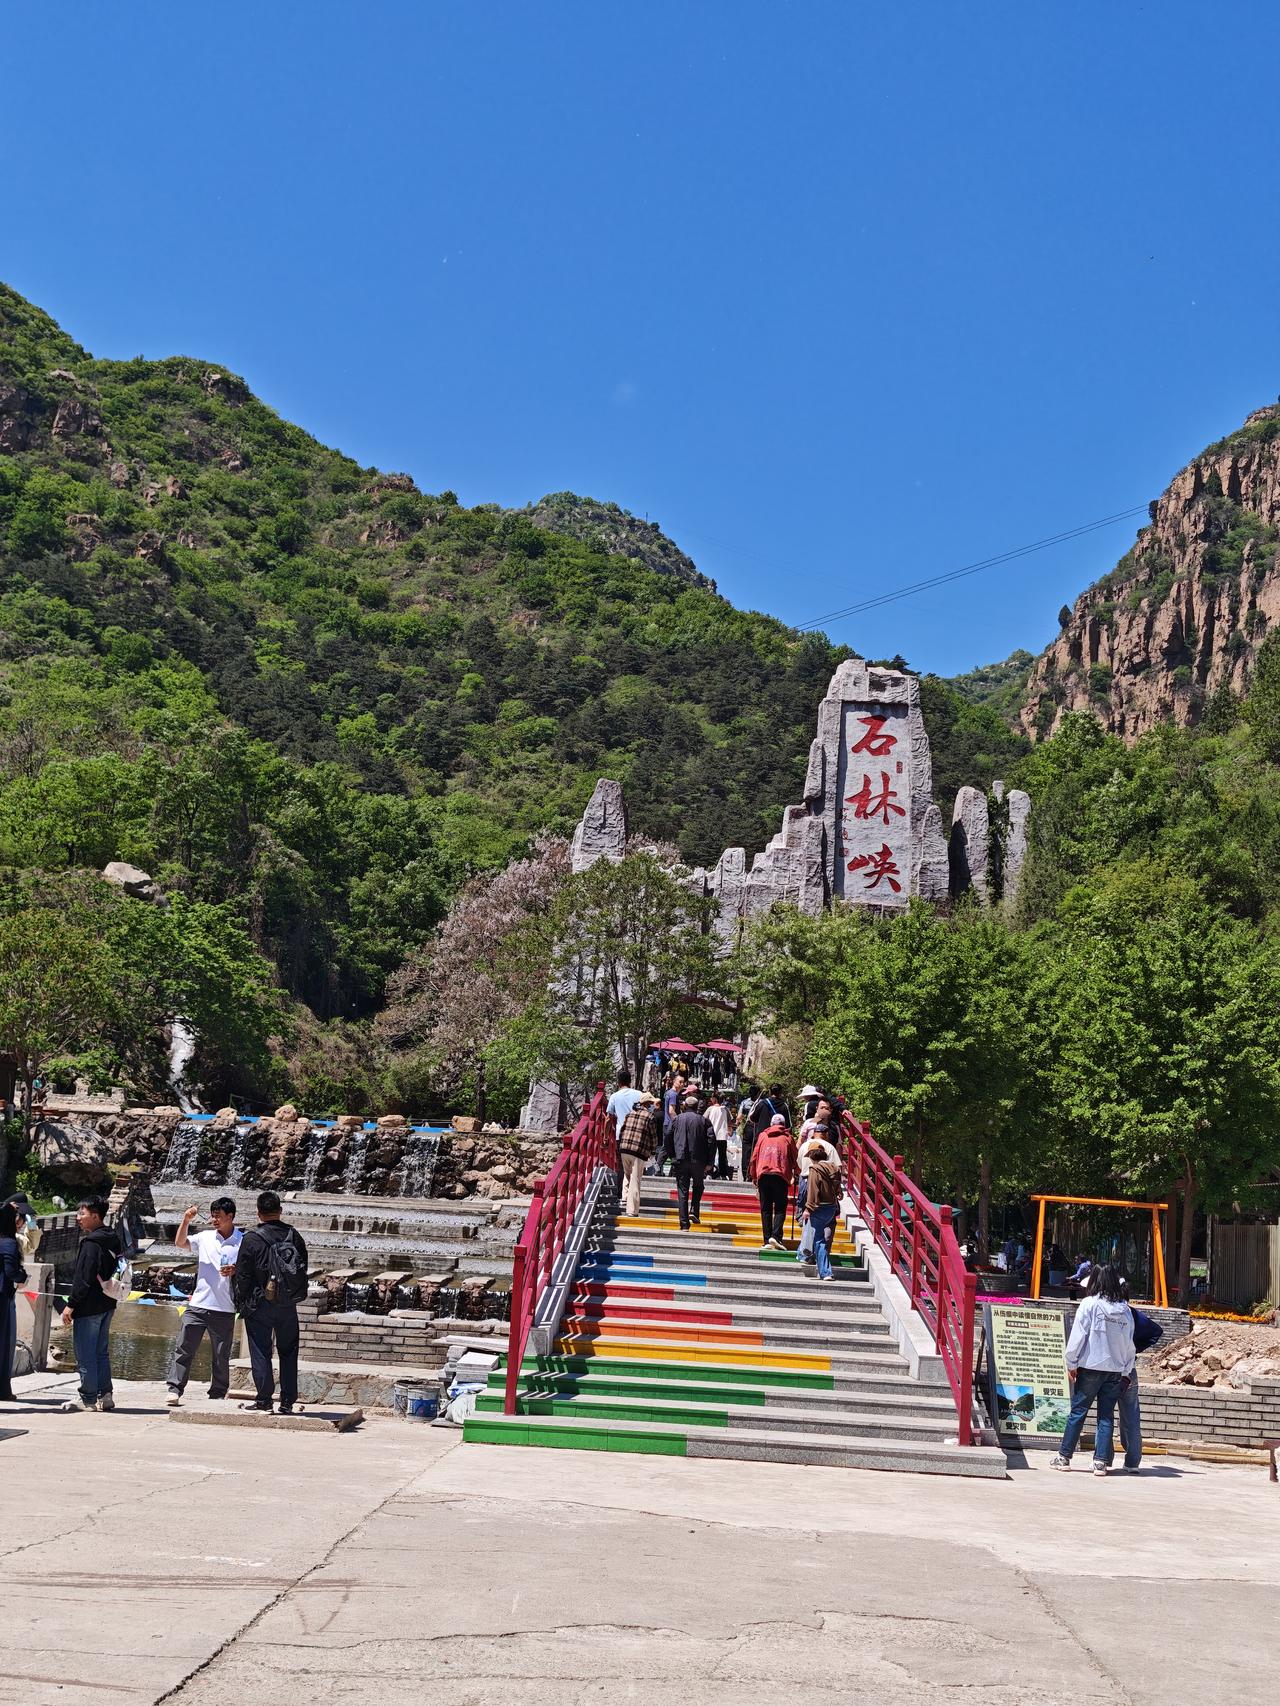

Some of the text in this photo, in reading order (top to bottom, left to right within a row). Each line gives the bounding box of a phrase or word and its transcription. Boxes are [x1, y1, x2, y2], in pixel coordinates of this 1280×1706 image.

[844, 715, 906, 893] 石林峡
[993, 1309, 1062, 1322] 从伤痕中读懂自然的力量
[1043, 1387, 1064, 1397] 受灾后
[1005, 1421, 1027, 1431] 受灾前
